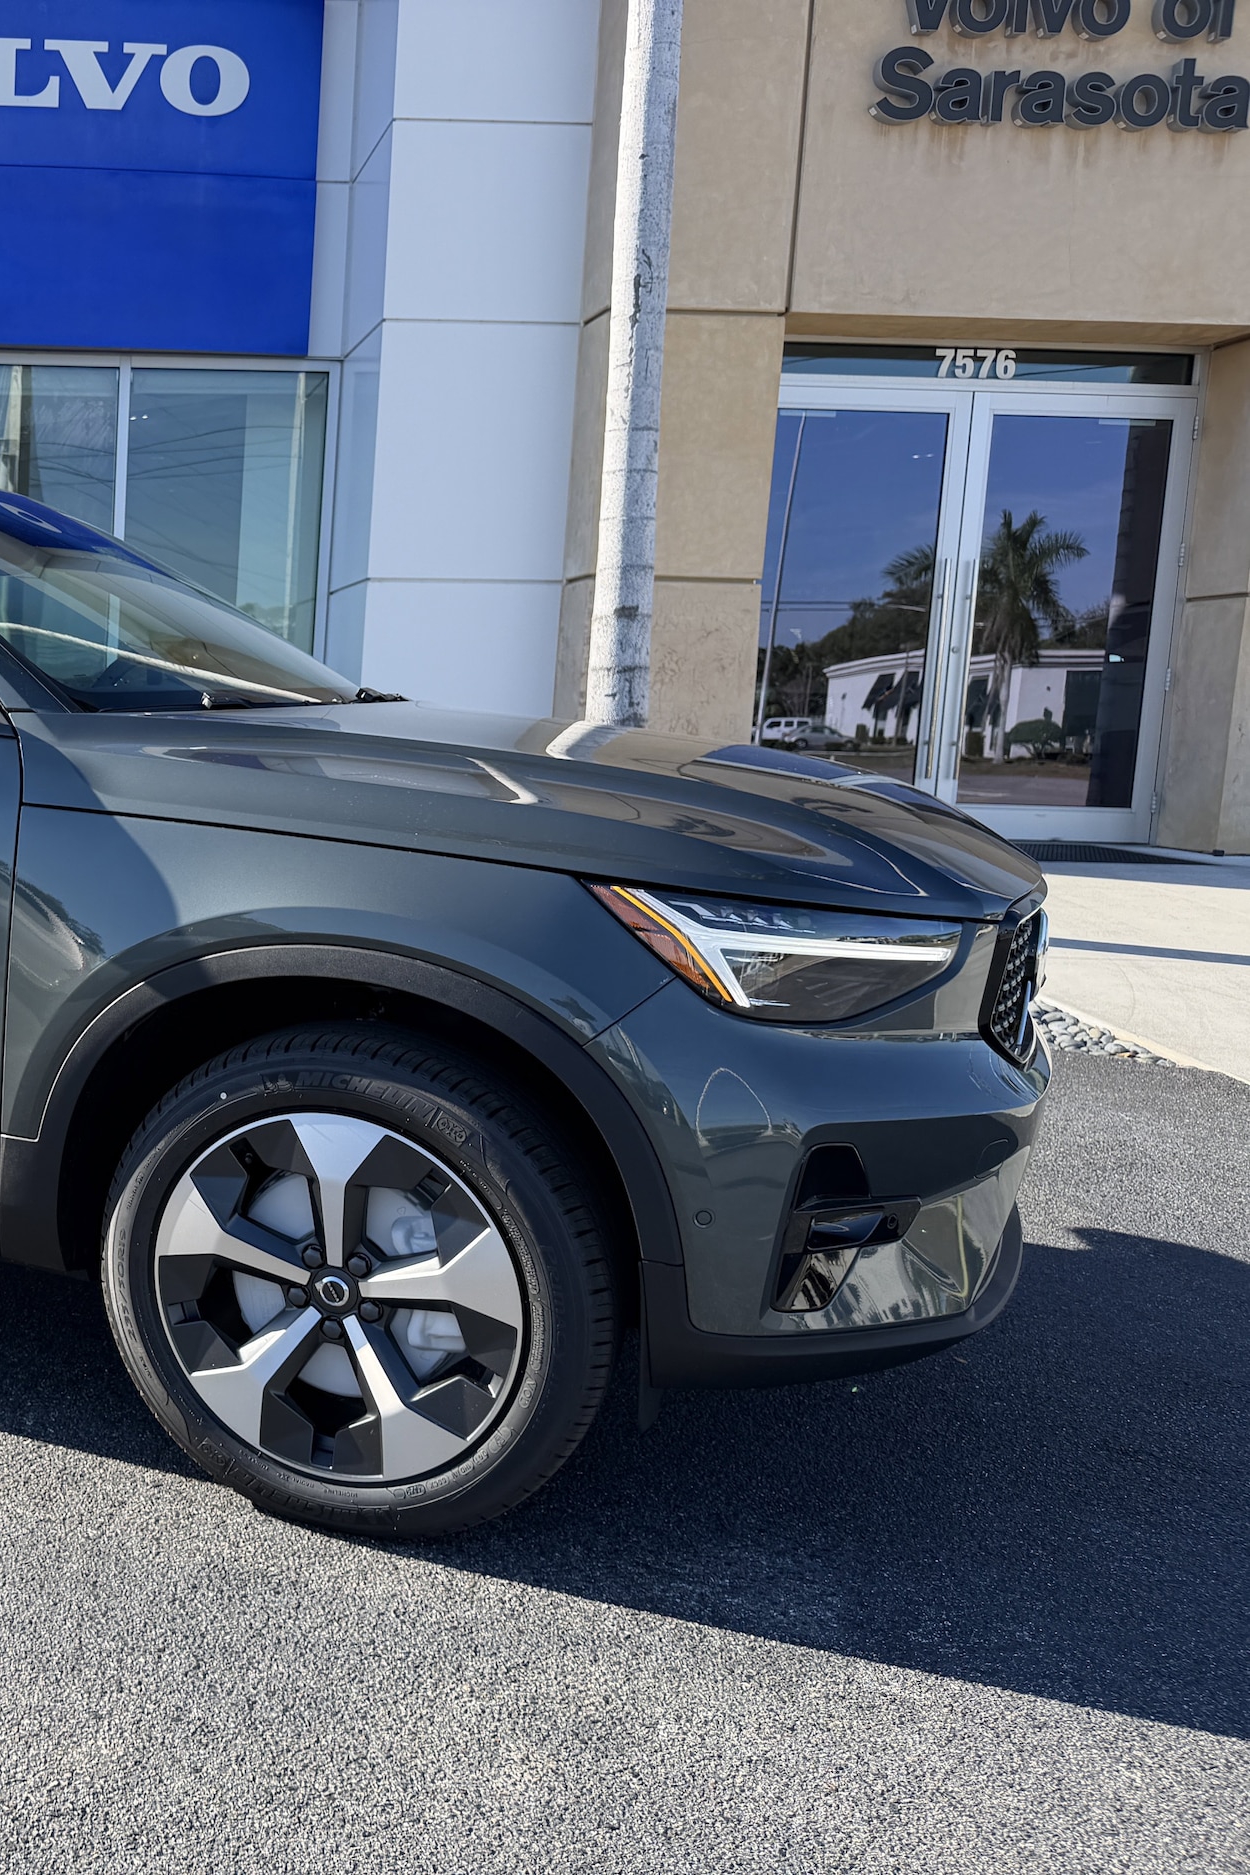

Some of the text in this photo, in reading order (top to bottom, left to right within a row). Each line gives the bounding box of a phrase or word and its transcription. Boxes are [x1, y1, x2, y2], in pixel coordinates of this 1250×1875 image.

[869, 46, 1250, 132] Sarasota
[935, 348, 1017, 380] 7576
[295, 1070, 437, 1121] MICHELIN
